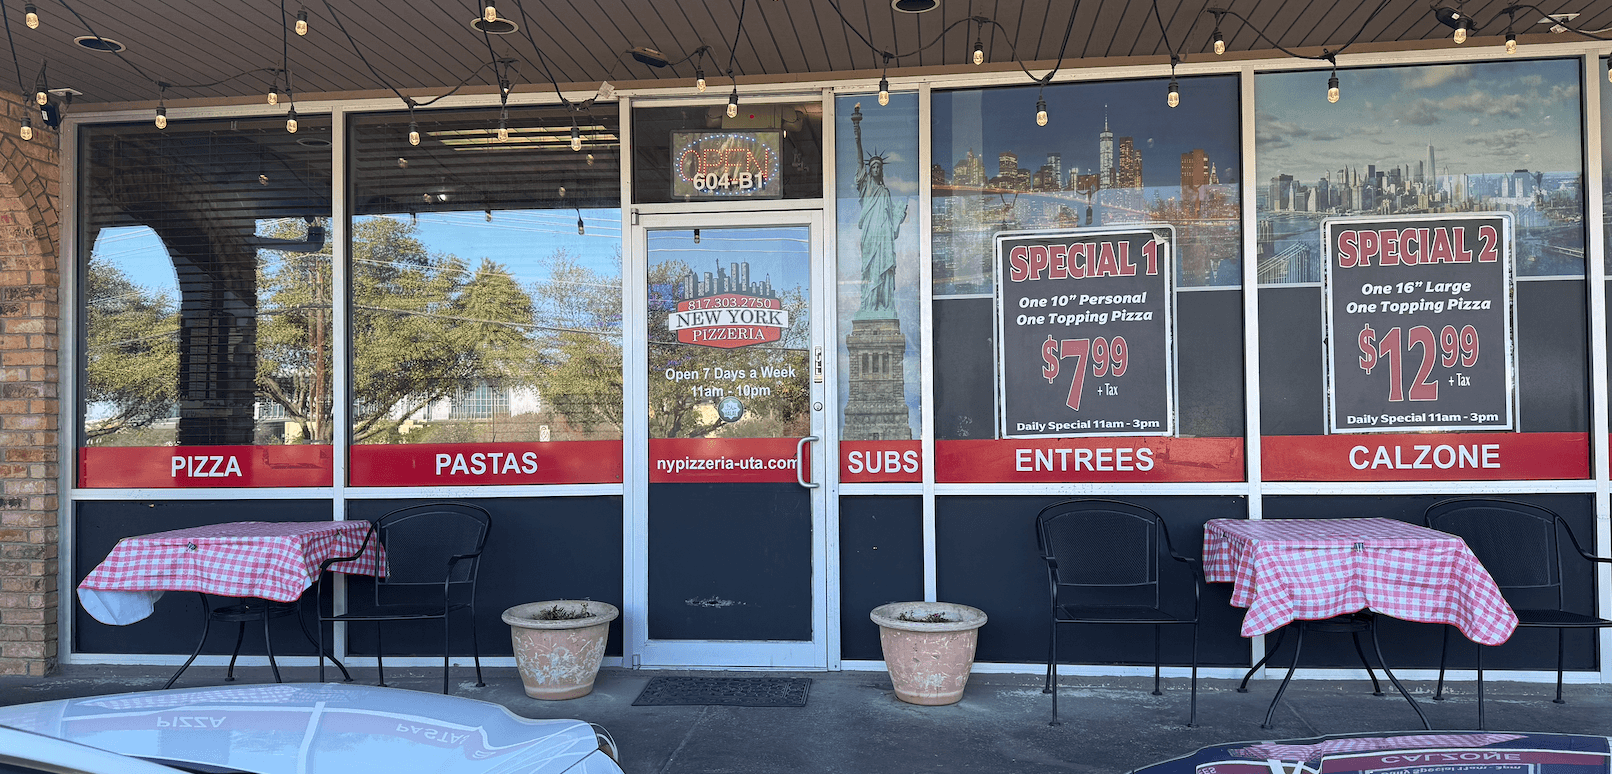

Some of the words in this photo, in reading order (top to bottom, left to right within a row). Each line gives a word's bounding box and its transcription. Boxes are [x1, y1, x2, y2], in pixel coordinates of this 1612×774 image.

[680, 148, 769, 181] OPEN
[693, 172, 763, 190] 604-B1
[1337, 226, 1472, 268] SPECIAL
[1478, 225, 1498, 263] 2
[1010, 241, 1137, 282] SPECIAL
[1142, 240, 1159, 276] 1
[1361, 283, 1393, 295] One
[1425, 281, 1472, 295] Large
[688, 297, 772, 311] 817.303.2750
[1019, 296, 1048, 309] One
[1079, 292, 1147, 306] Personal
[1346, 302, 1377, 314] One
[1380, 298, 1444, 315] Topping
[1447, 297, 1491, 311] Pizza
[676, 311, 724, 328] NEW
[729, 309, 784, 326] YORK
[1016, 314, 1045, 326] One
[1048, 310, 1108, 326] Topping
[1111, 309, 1153, 322] Pizza
[692, 327, 766, 342] PIZZERIA
[665, 367, 699, 382] Open
[702, 367, 710, 379] 7
[714, 367, 746, 381] Days
[749, 369, 758, 379] a
[761, 366, 796, 379] Week
[1456, 372, 1471, 387] Tax
[691, 385, 724, 397] 11am
[736, 384, 771, 399] 10pm
[1104, 382, 1119, 396] Tax
[1016, 421, 1046, 432] Daily
[1048, 419, 1091, 431] Special
[1093, 420, 1124, 429] 11am
[1132, 419, 1160, 430] 3pm
[1347, 414, 1378, 425] Daily
[1380, 412, 1426, 424] Special
[1428, 413, 1461, 422] 11am
[1470, 412, 1498, 423] 3pm
[435, 452, 538, 475] PASTAS
[848, 450, 919, 474] SUBS
[1015, 447, 1154, 472] ENTREES
[1349, 444, 1501, 470] CALZONE
[171, 456, 242, 477] PIZZA
